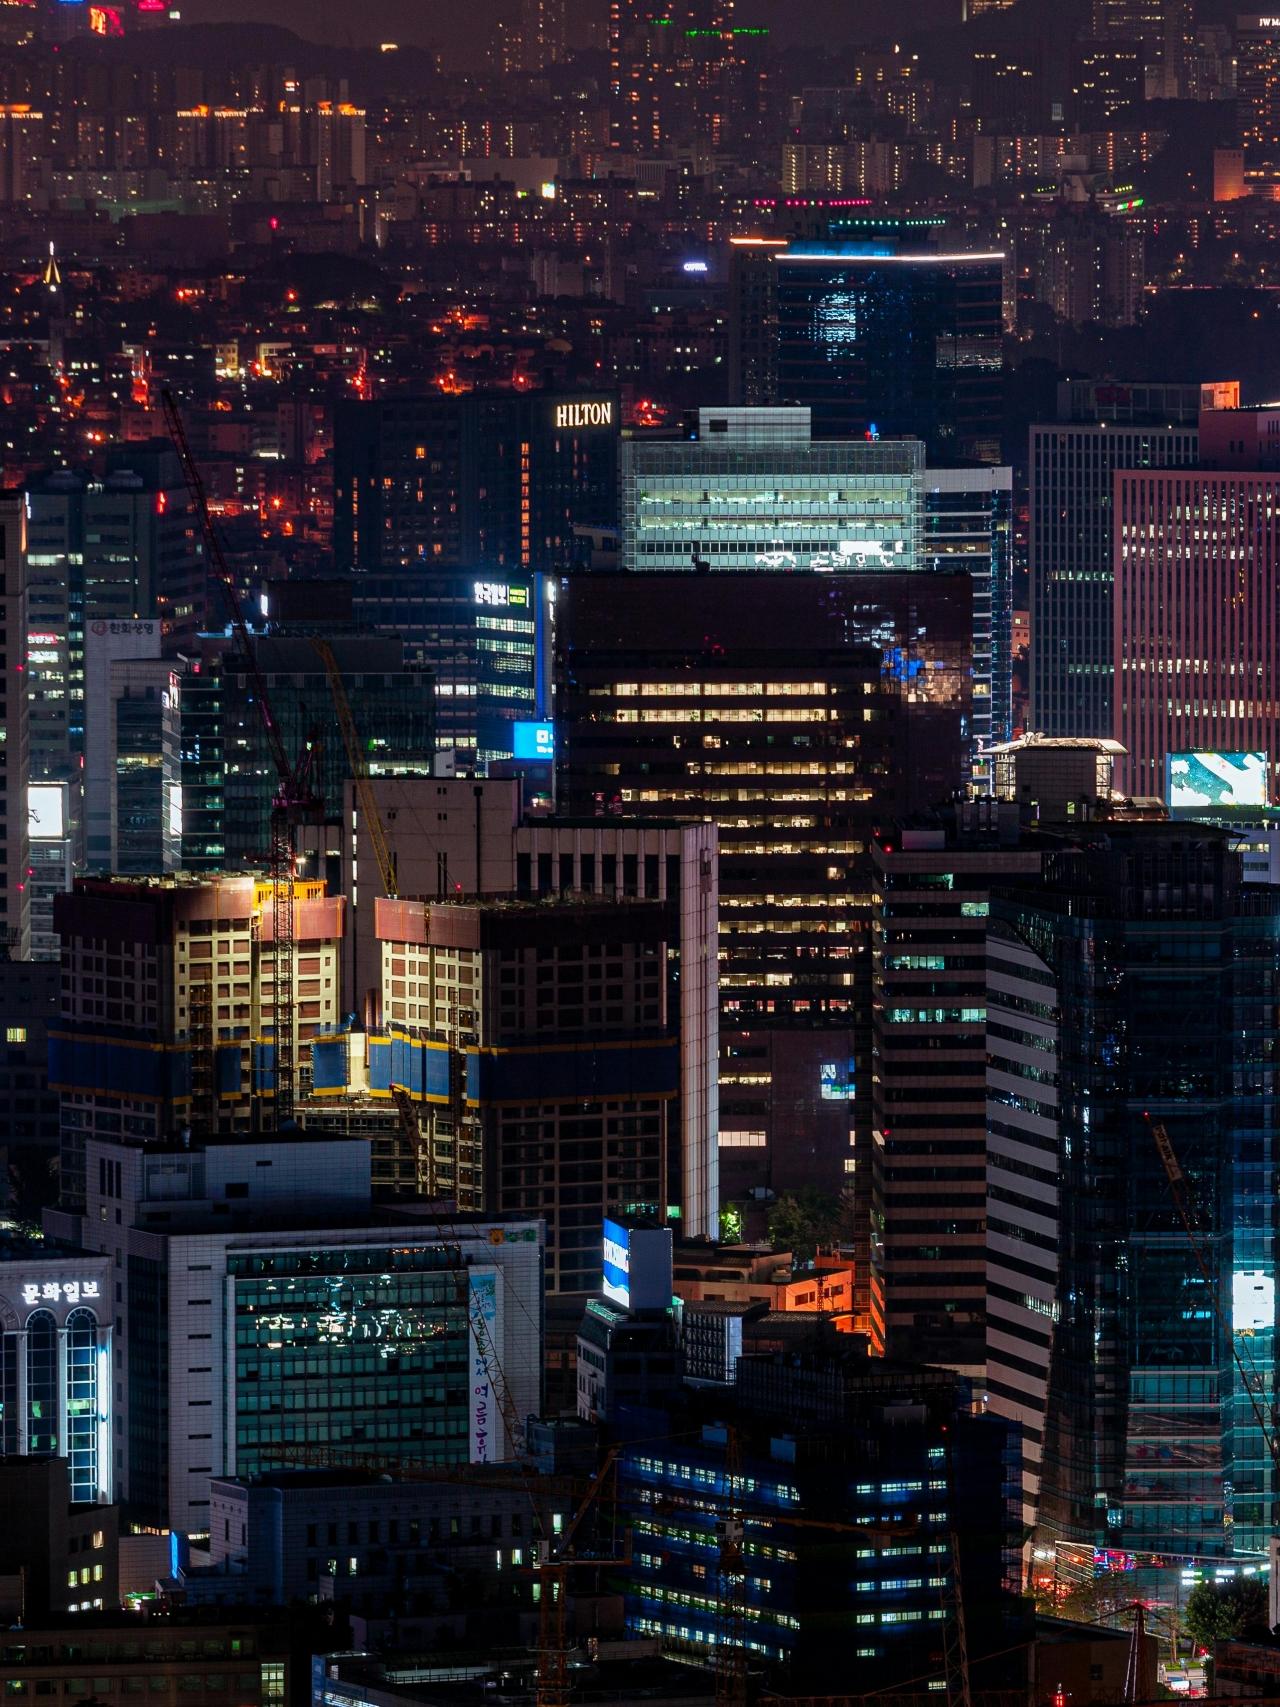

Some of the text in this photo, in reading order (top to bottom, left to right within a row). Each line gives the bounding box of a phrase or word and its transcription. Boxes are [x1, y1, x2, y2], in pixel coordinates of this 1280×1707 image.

[1259, 18, 1270, 27] JW
[556, 402, 612, 427] HILTON
[109, 622, 154, 635] 한화생명
[21, 1282, 101, 1305] 문화일보
